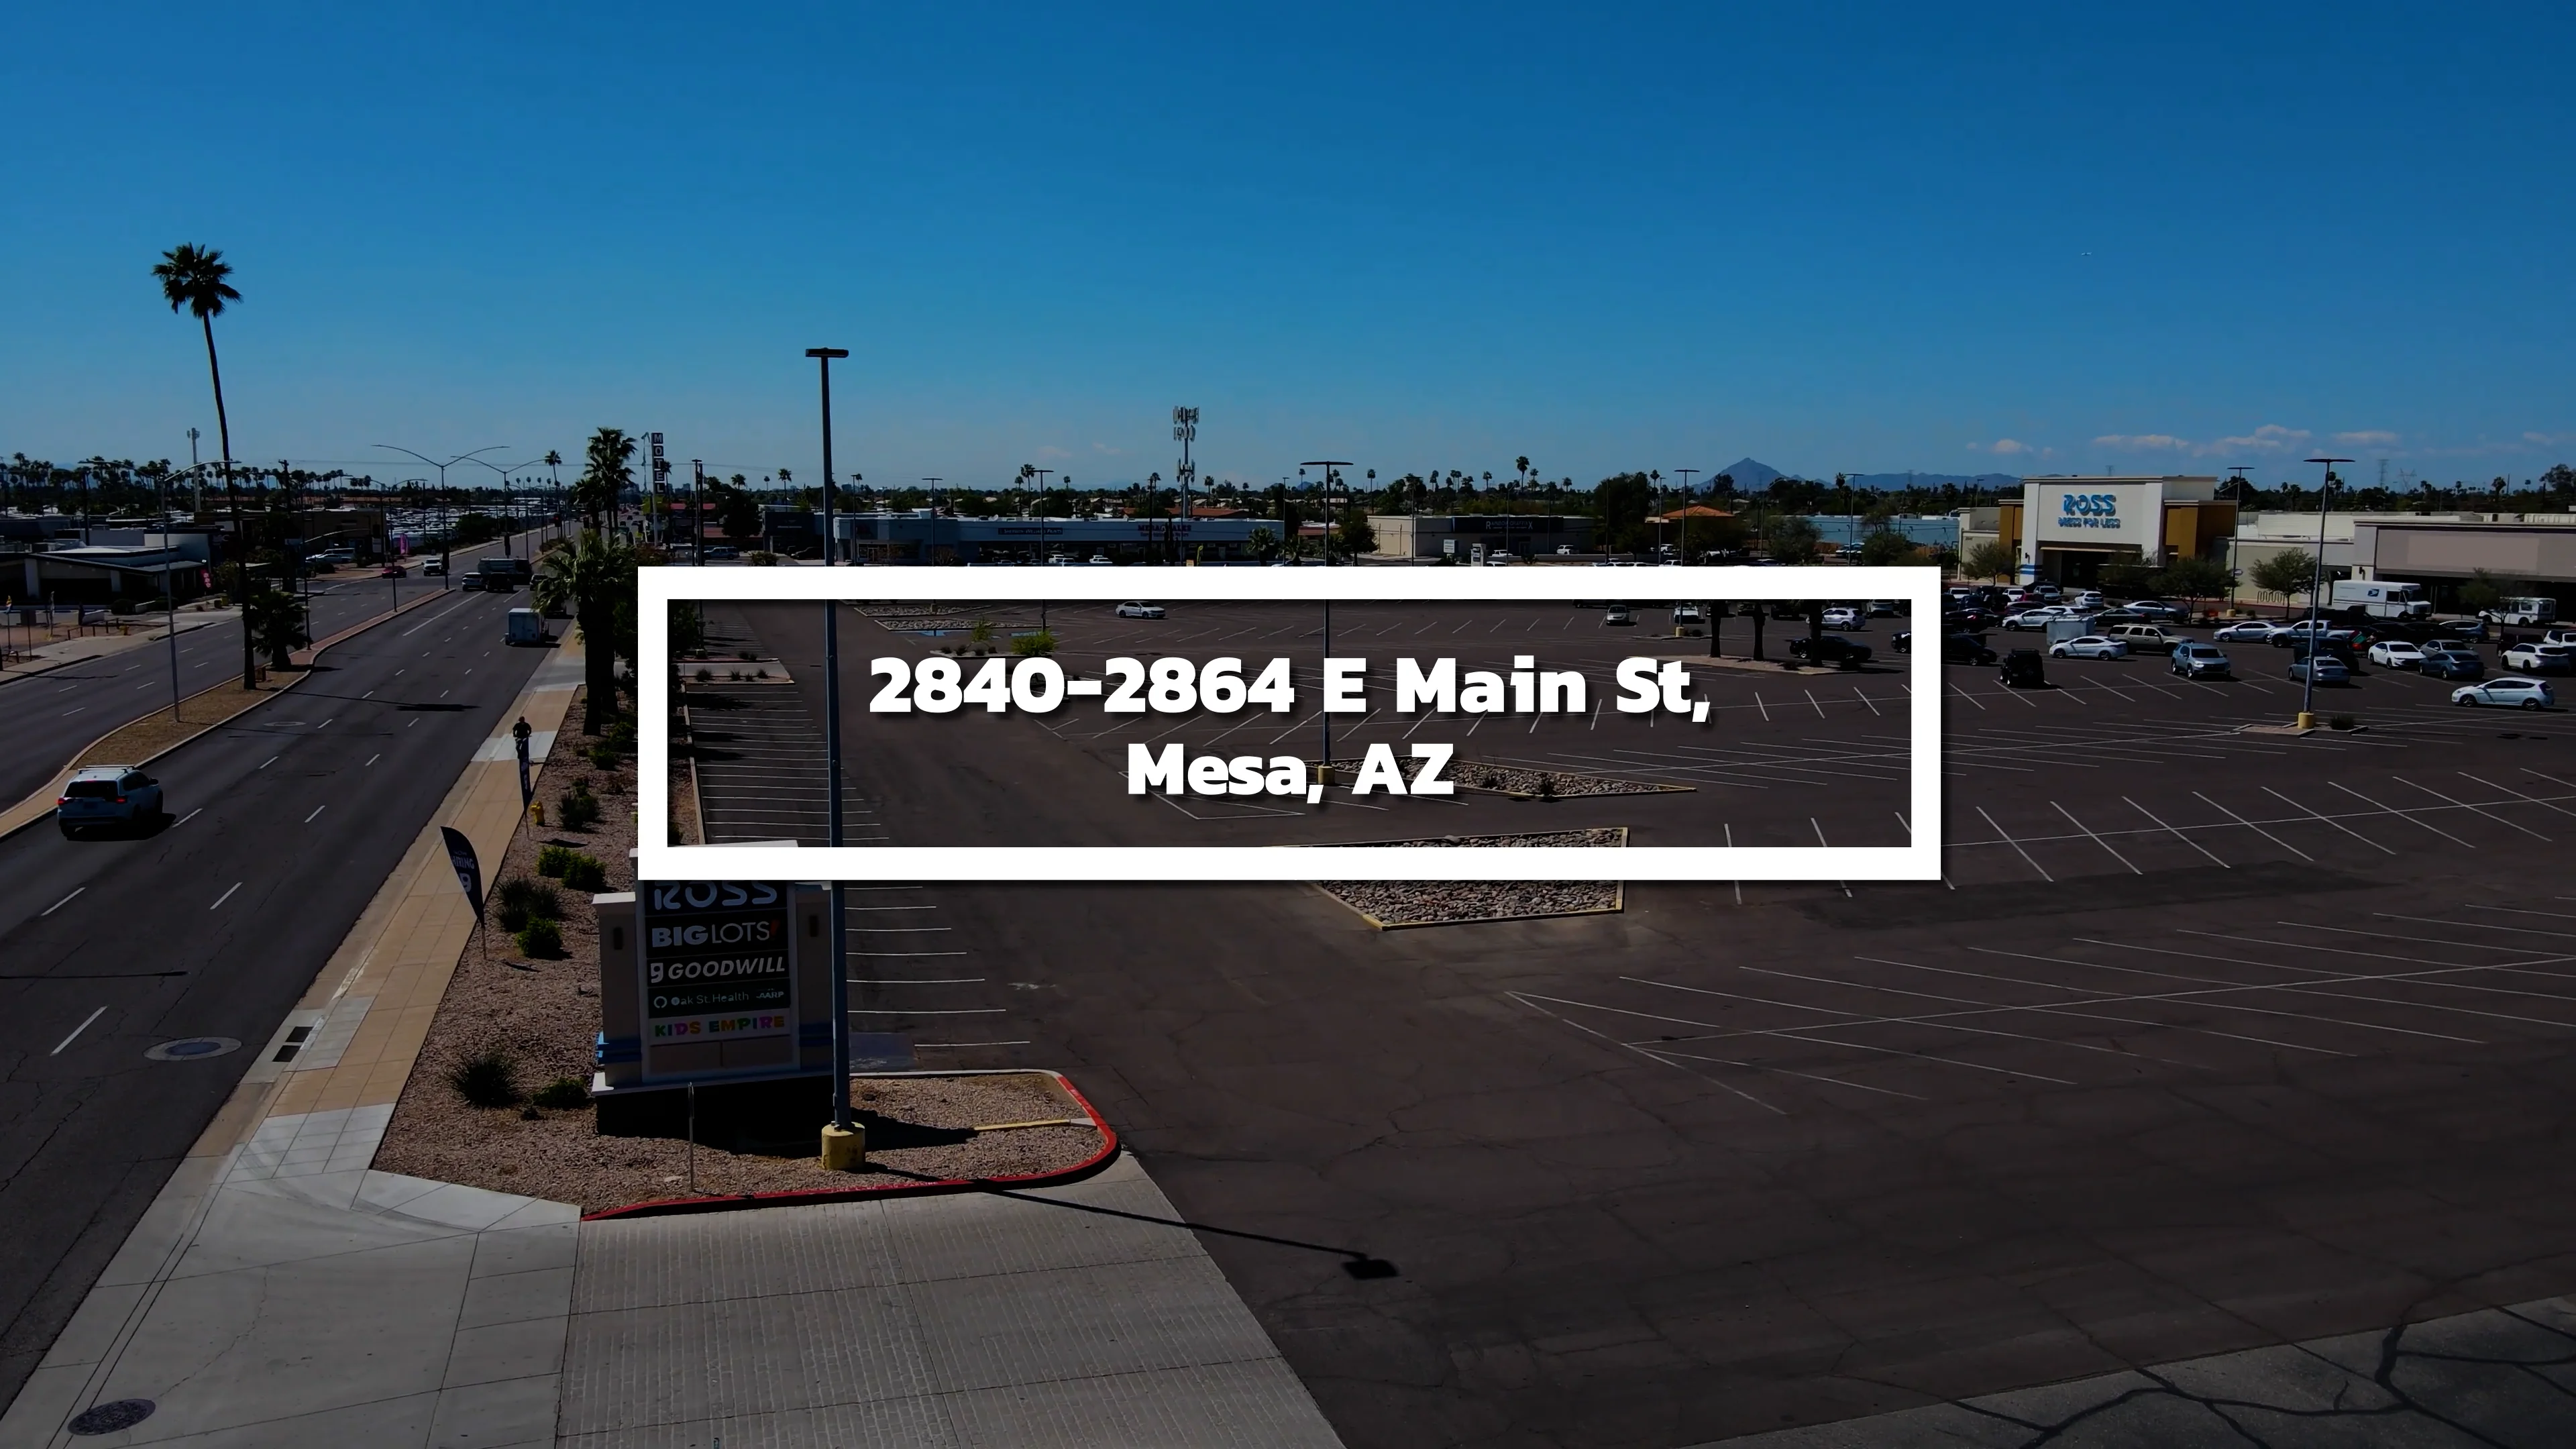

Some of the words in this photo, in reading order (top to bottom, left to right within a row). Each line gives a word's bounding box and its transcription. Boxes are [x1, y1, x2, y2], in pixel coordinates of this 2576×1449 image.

[653, 433, 664, 493] MOTEL
[2063, 494, 2115, 515] ROSS
[654, 880, 777, 910] ROSS
[668, 956, 786, 979] GOODWILL
[671, 996, 694, 1006] Oak
[712, 991, 749, 1002] Health
[756, 990, 784, 999] AARP
[655, 1021, 701, 1037] KIDS
[708, 1016, 785, 1032] EMPIRE
